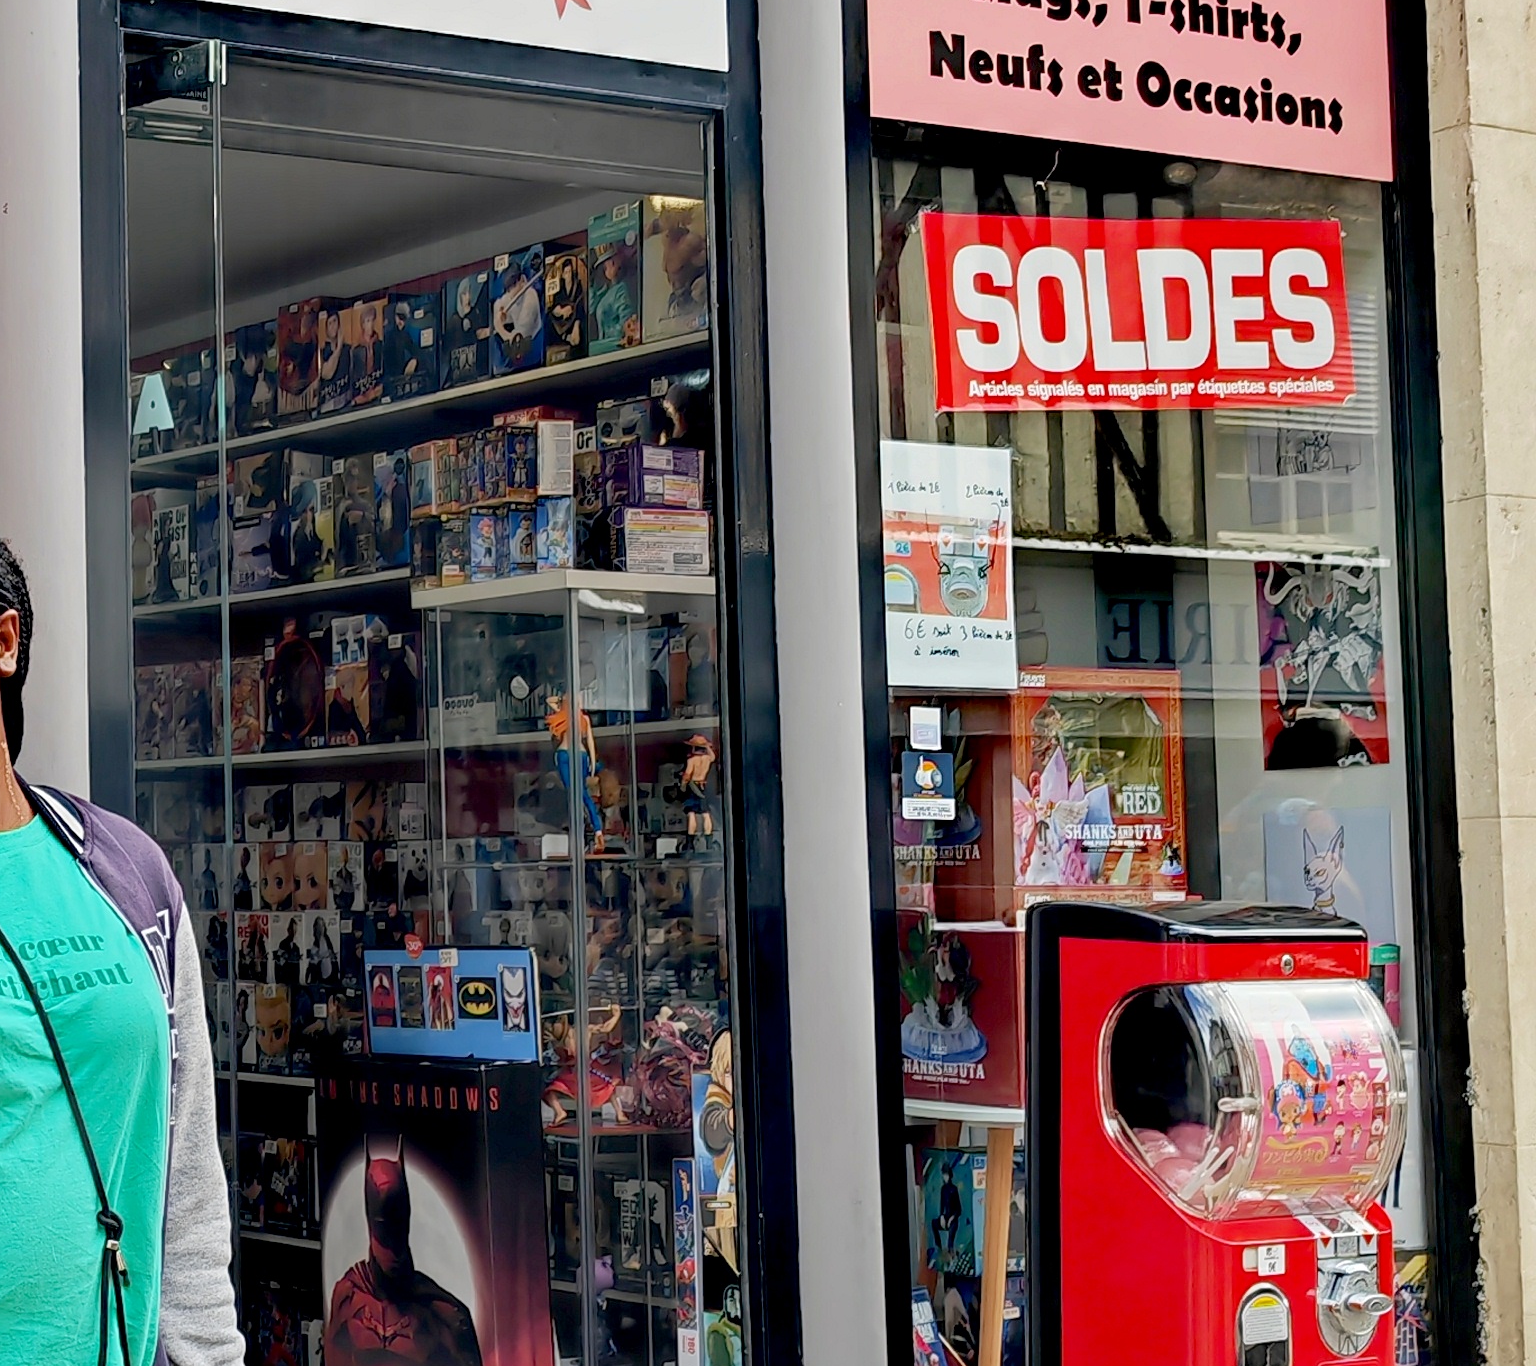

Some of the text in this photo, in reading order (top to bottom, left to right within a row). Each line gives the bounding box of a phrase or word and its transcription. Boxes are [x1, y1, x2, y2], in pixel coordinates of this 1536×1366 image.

[929, 31, 1343, 134] Neufs et Occasions
[952, 244, 1335, 373] SOLDES
[968, 376, 1335, 400] Articles signalés en magasin par étiquettes spéciales
[904, 618, 927, 640] 6€
[1122, 792, 1162, 815] RED
[1065, 824, 1117, 841] SHANKS
[1135, 823, 1164, 841] UTA
[18, 934, 105, 962] cœur
[959, 1062, 986, 1081] UTA
[394, 1083, 501, 1112] SHADOWS
